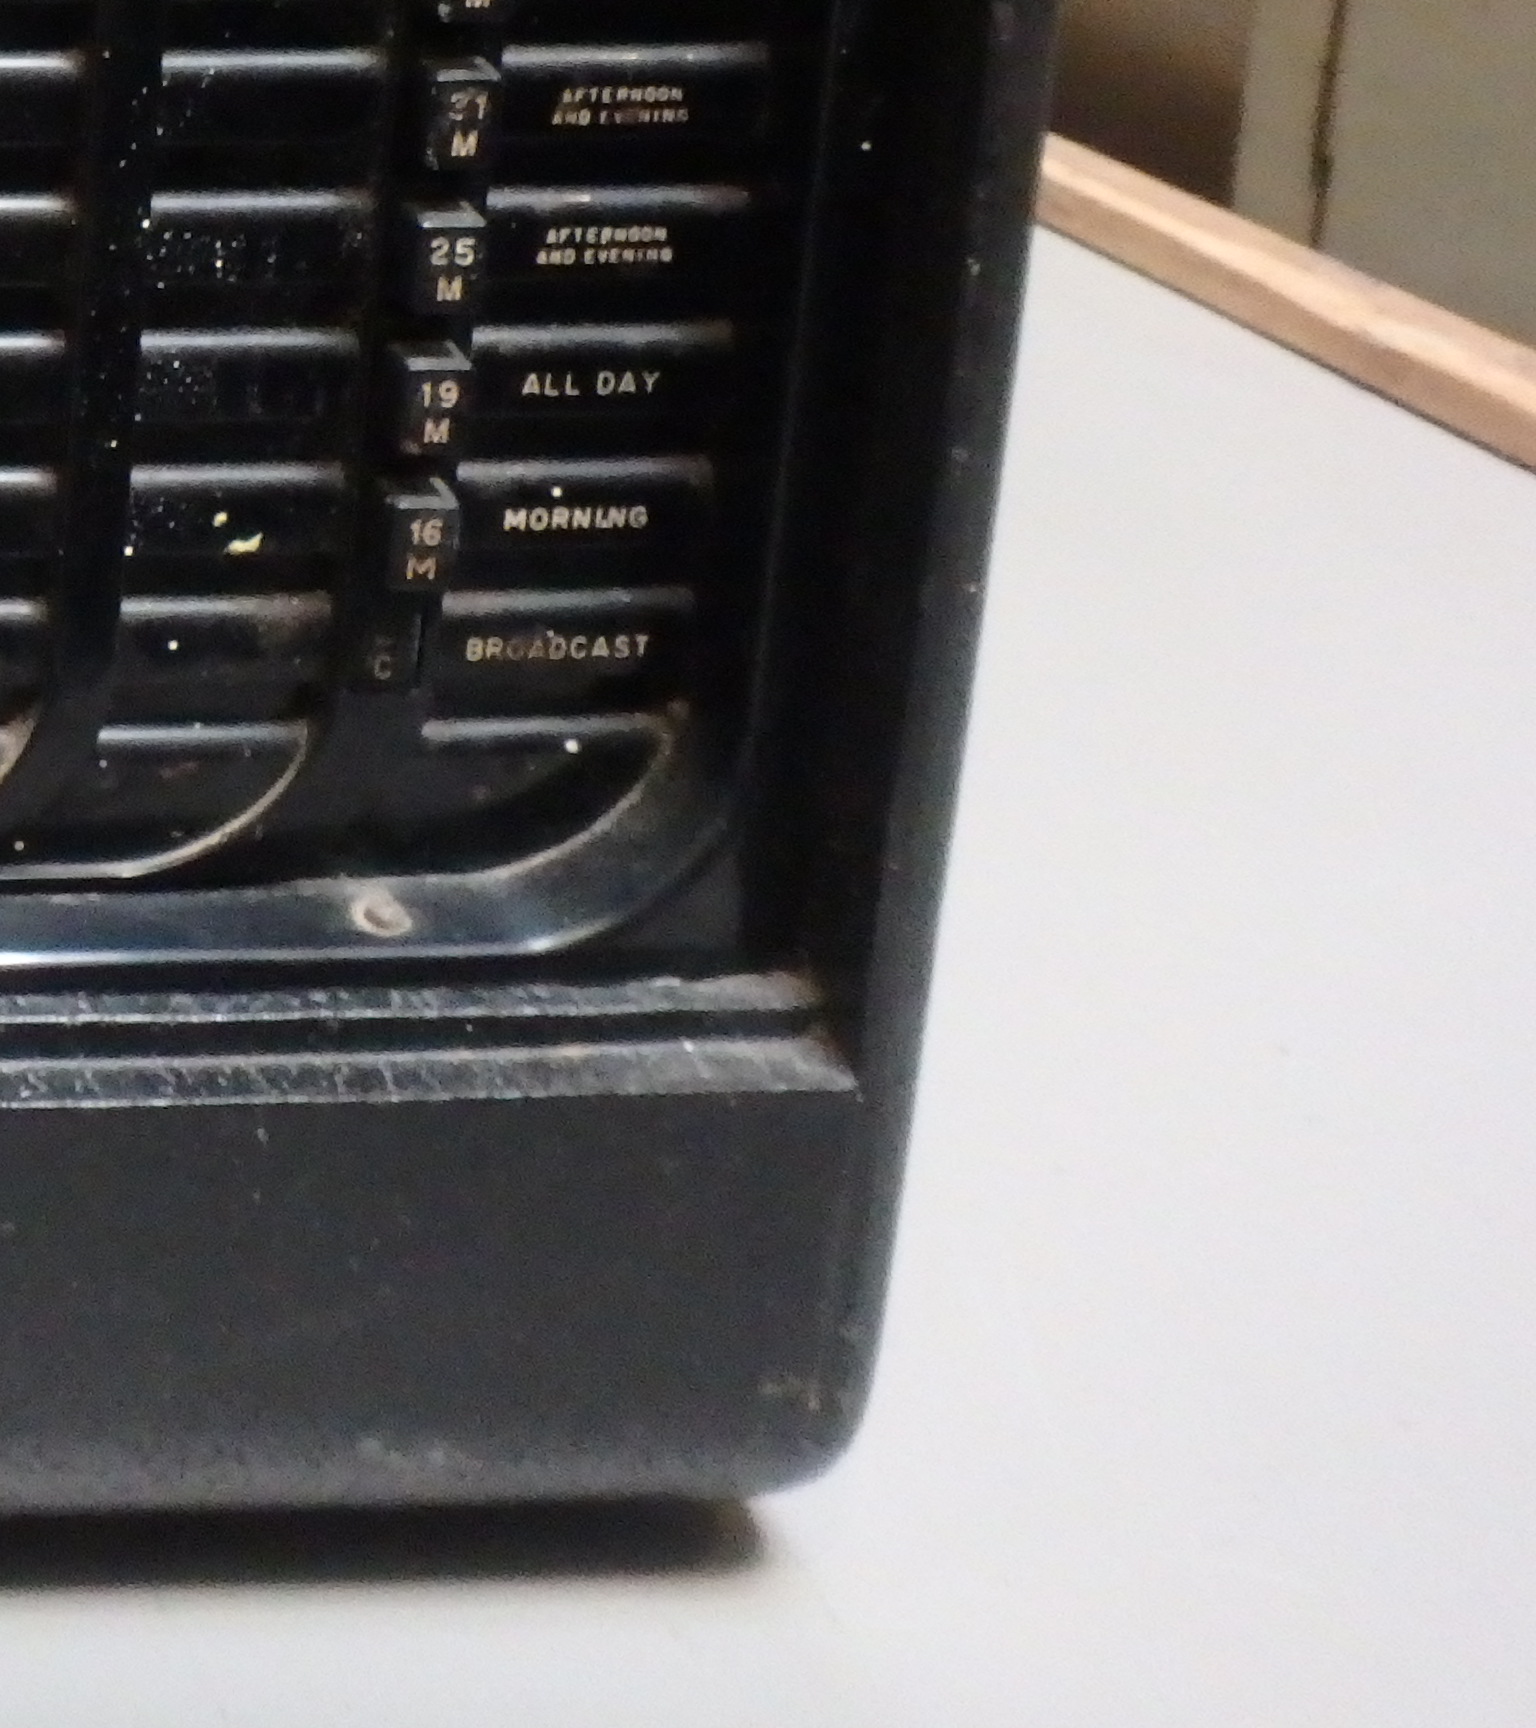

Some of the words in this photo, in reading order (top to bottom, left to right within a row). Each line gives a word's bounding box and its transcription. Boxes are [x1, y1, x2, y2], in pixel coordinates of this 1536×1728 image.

[562, 86, 684, 103] AFTERNOON
[551, 108, 591, 126] AND
[450, 129, 479, 157] M
[545, 226, 668, 245] AFTERNOON
[429, 236, 477, 266] 25
[536, 247, 577, 265] AND
[584, 247, 674, 264] EVENING
[435, 274, 463, 302] M
[421, 380, 461, 409] 19
[521, 373, 580, 397] ALL
[596, 371, 662, 396] DAY
[423, 416, 451, 444] M
[410, 518, 444, 547] 16
[502, 505, 650, 533] MORNING
[405, 558, 437, 580] M
[465, 634, 651, 663] BROADCAST
